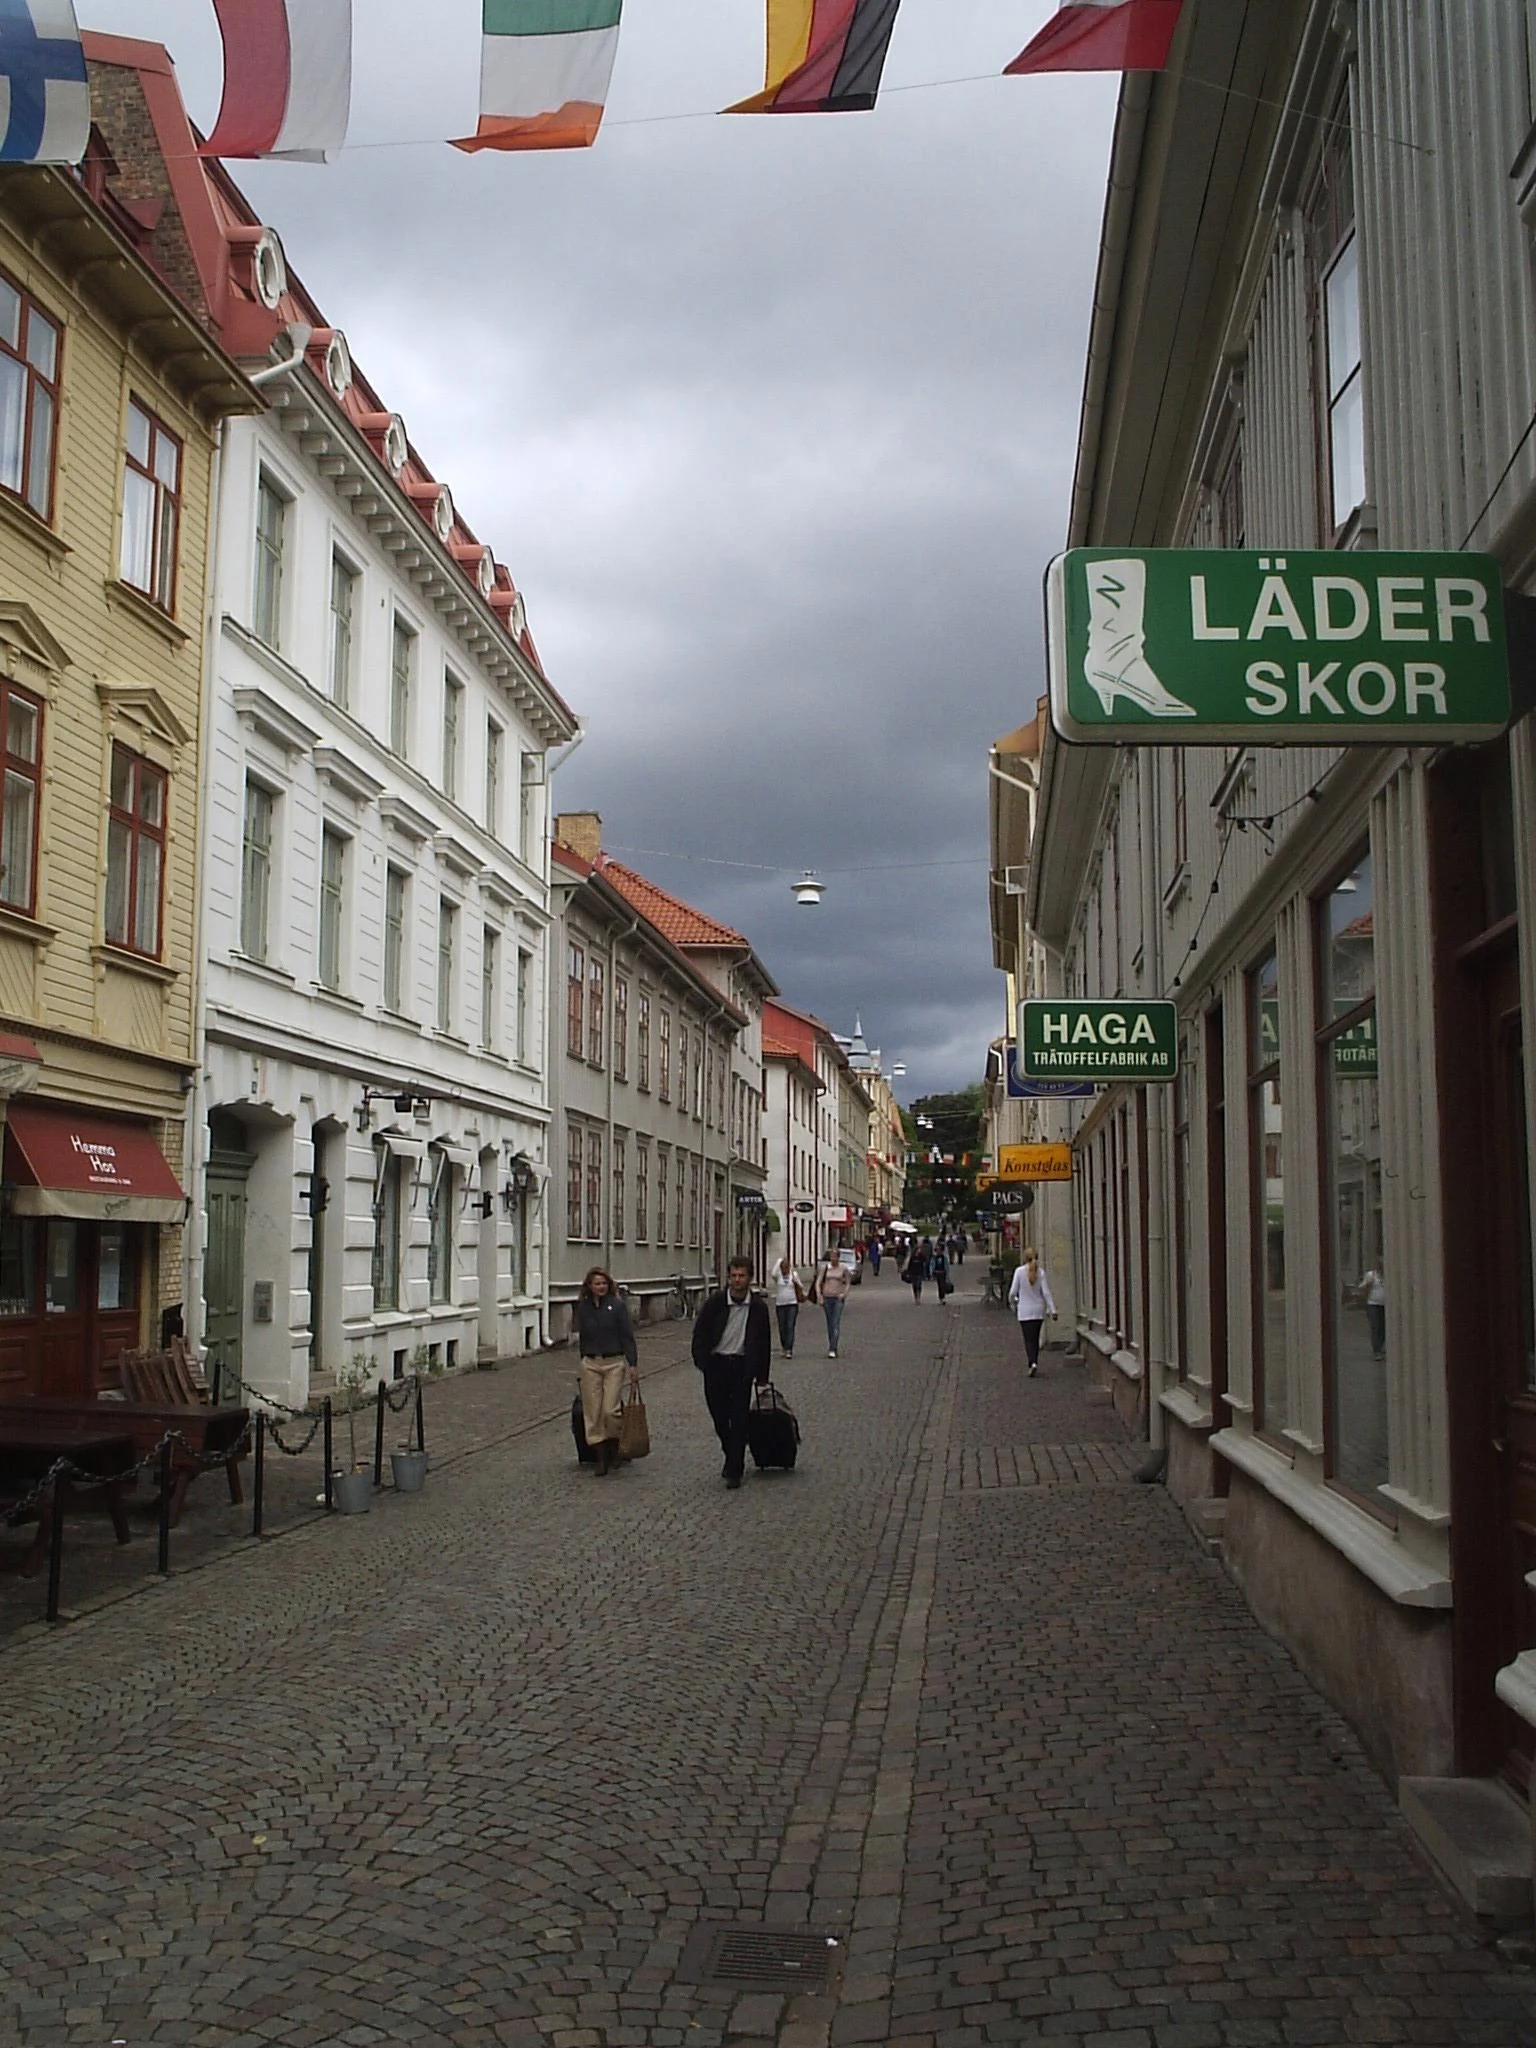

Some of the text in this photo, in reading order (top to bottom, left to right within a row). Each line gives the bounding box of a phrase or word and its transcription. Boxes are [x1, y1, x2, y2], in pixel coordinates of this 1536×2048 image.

[1190, 558, 1492, 642] LÄDER
[1245, 661, 1448, 716] SKOR
[1043, 1013, 1156, 1045] HAGA
[1032, 1048, 1168, 1066] TRÄTOFFELFABRIK AB
[70, 1135, 116, 1157] Hemma
[89, 1154, 116, 1174] Hos
[1004, 1156, 1069, 1175] Konstglas
[992, 1191, 1024, 1205] PACS
